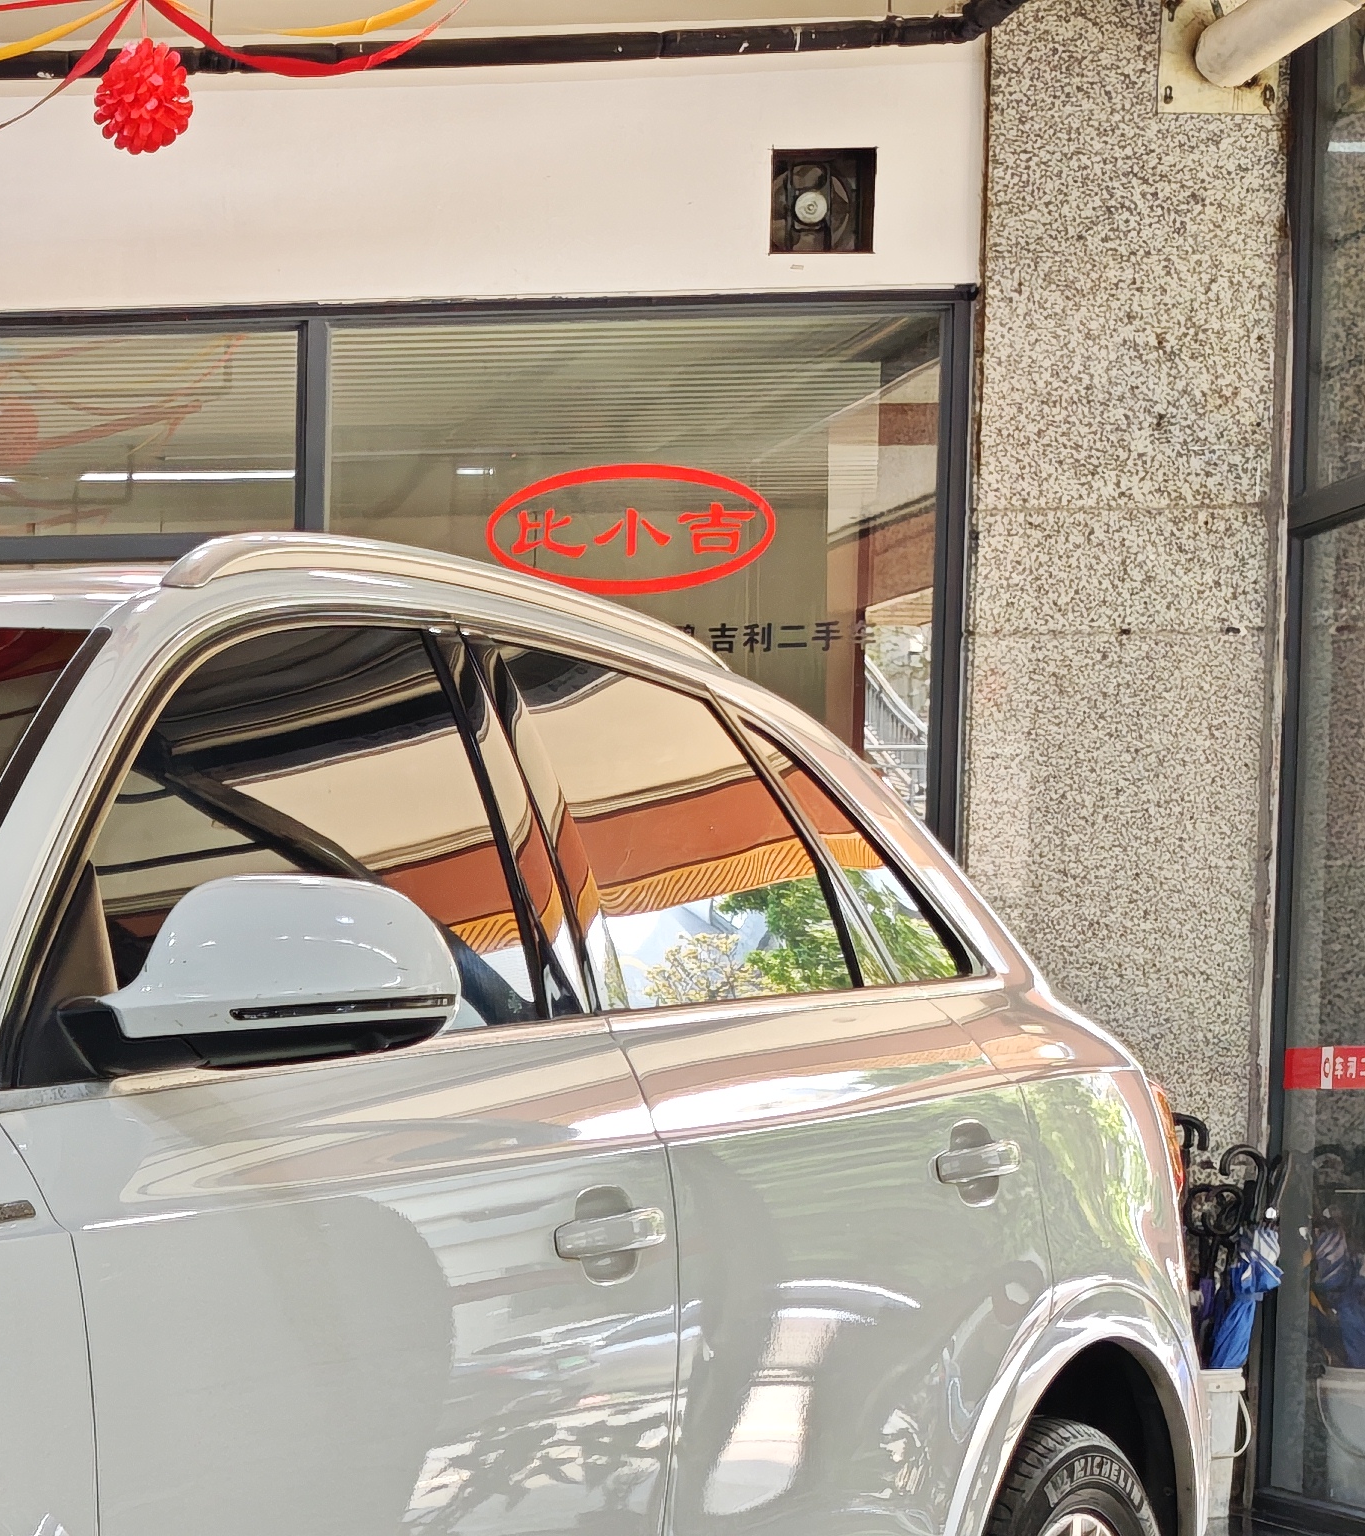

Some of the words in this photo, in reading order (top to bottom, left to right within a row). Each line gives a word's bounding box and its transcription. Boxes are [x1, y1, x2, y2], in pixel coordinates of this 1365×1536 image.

[511, 502, 756, 558] 比小吉
[1073, 1456, 1144, 1508] MICHELIN
